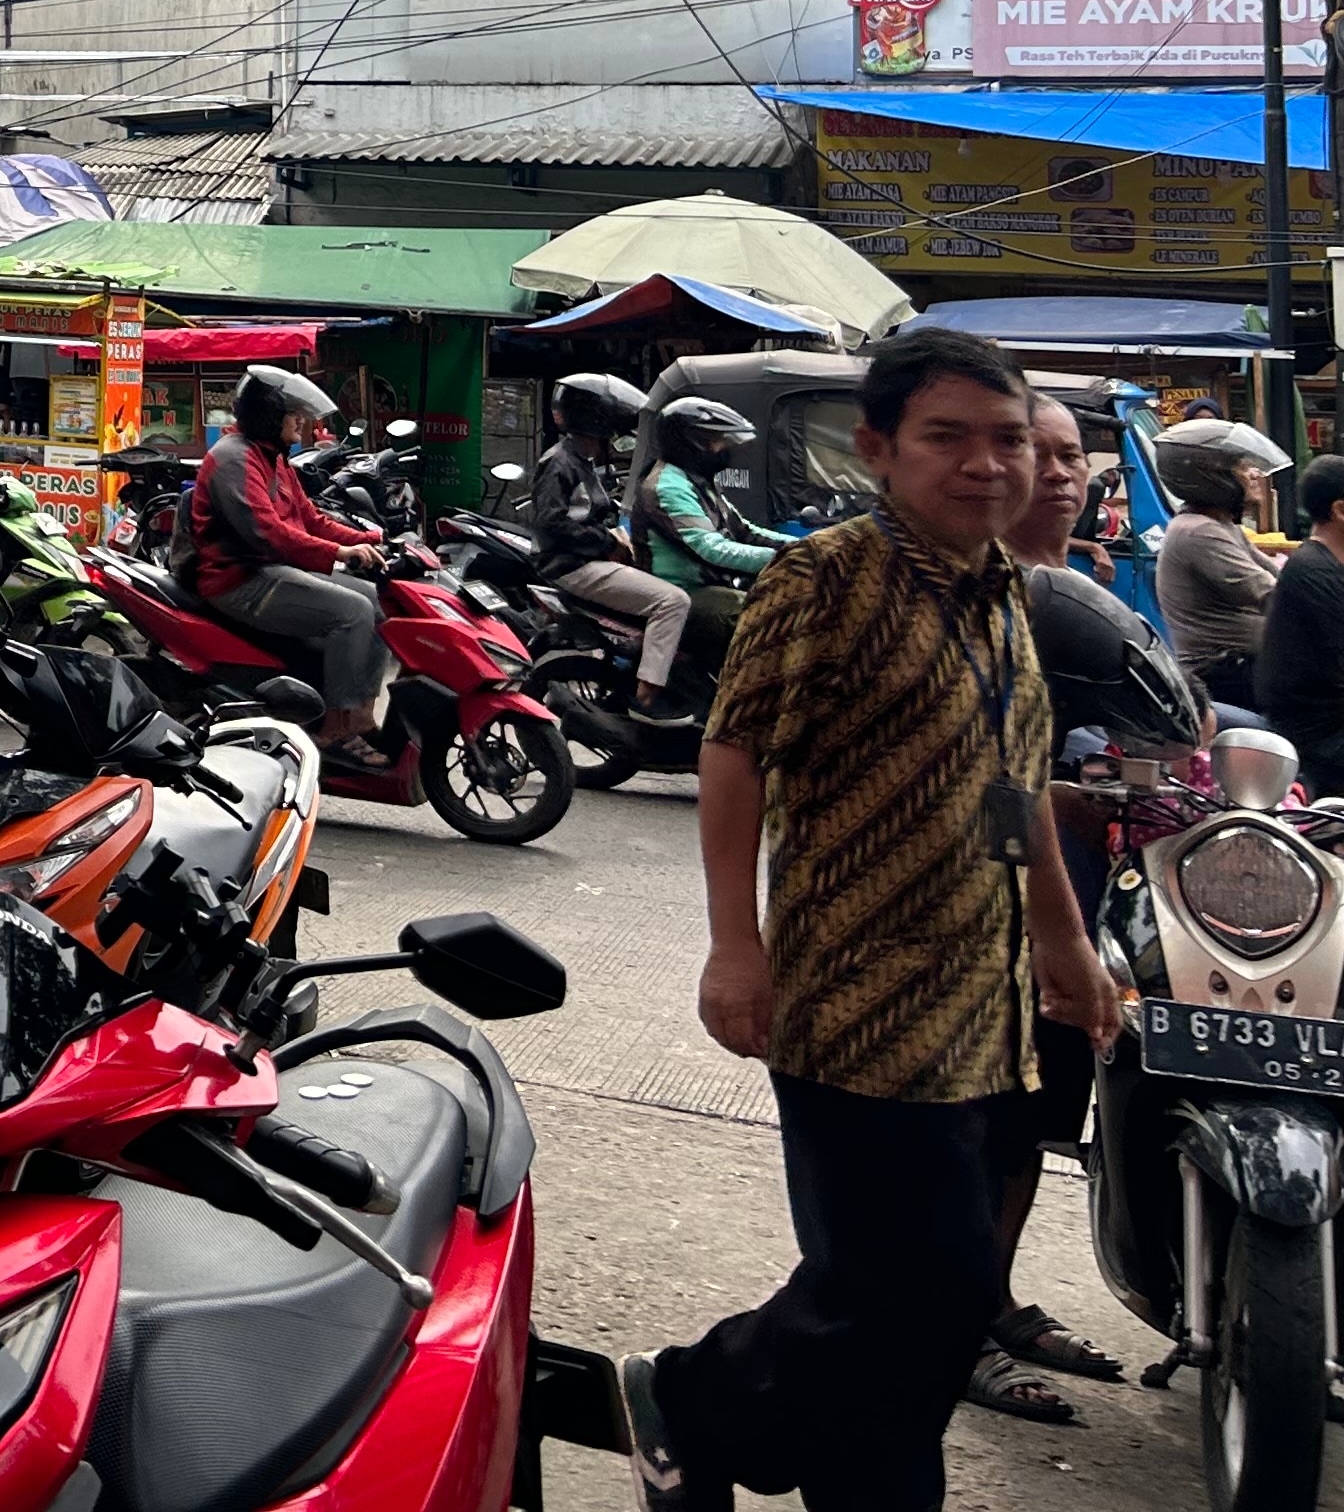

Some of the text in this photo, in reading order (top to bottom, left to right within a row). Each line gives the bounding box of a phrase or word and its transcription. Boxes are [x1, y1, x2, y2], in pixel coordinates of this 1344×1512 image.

[997, 0, 1067, 25] MIE
[1078, 0, 1194, 24] AYAM
[1020, 51, 1055, 61] Rasa
[1058, 50, 1085, 61] Teh
[1088, 49, 1144, 61] Terbaik
[1148, 49, 1178, 61] Ada
[1182, 49, 1197, 61] di
[826, 149, 931, 172] MAKANAN
[827, 184, 844, 200] MIE
[845, 184, 872, 201] AYAM
[929, 185, 947, 202] MIE
[948, 186, 976, 203] AYAM
[1155, 188, 1209, 202] ES CAMPUR
[1155, 209, 1167, 223] ES
[1196, 210, 1235, 224] DURIAN
[873, 238, 908, 255] JAMUR
[929, 239, 948, 257] MIE
[1155, 249, 1219, 264] LE MINERALE
[25, 306, 72, 318] PERAS
[107, 342, 142, 360] PERAS
[425, 422, 468, 436] TELOR
[21, 472, 97, 497] PERAS
[1151, 1005, 1344, 1058] B 6733 VL
